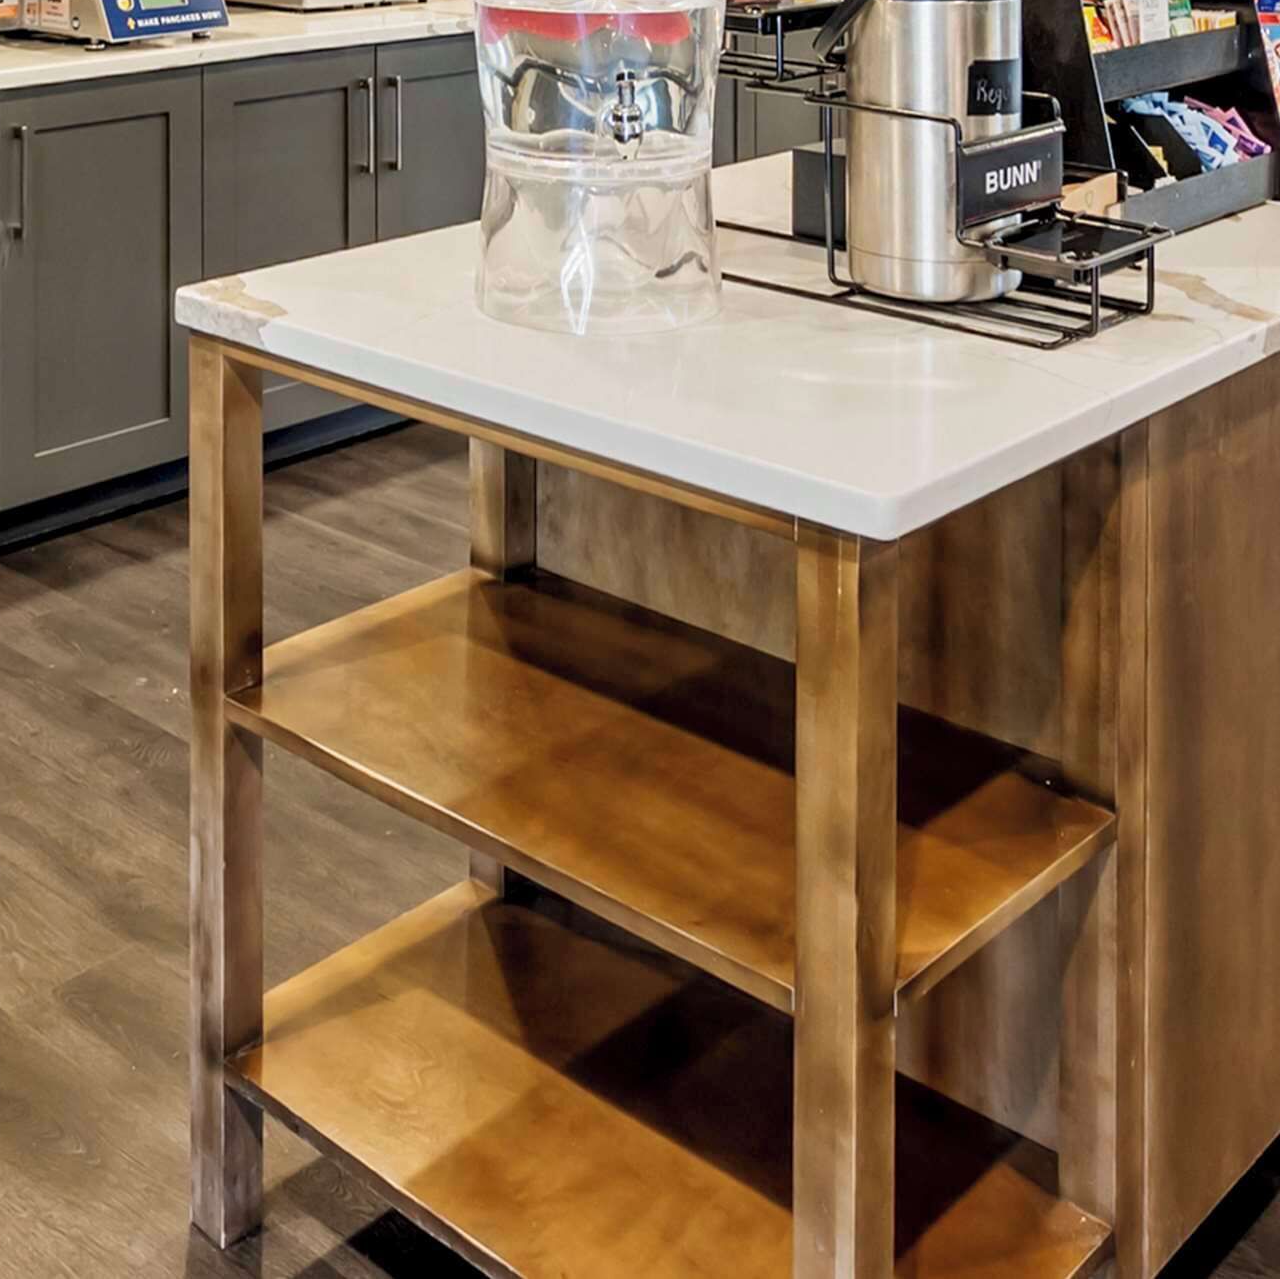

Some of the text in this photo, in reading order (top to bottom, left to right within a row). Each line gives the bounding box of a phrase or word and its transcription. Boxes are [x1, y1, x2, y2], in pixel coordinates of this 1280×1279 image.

[137, 17, 160, 27] MAKE
[161, 13, 200, 25] PANCAKES
[985, 160, 1041, 195] BUNN
